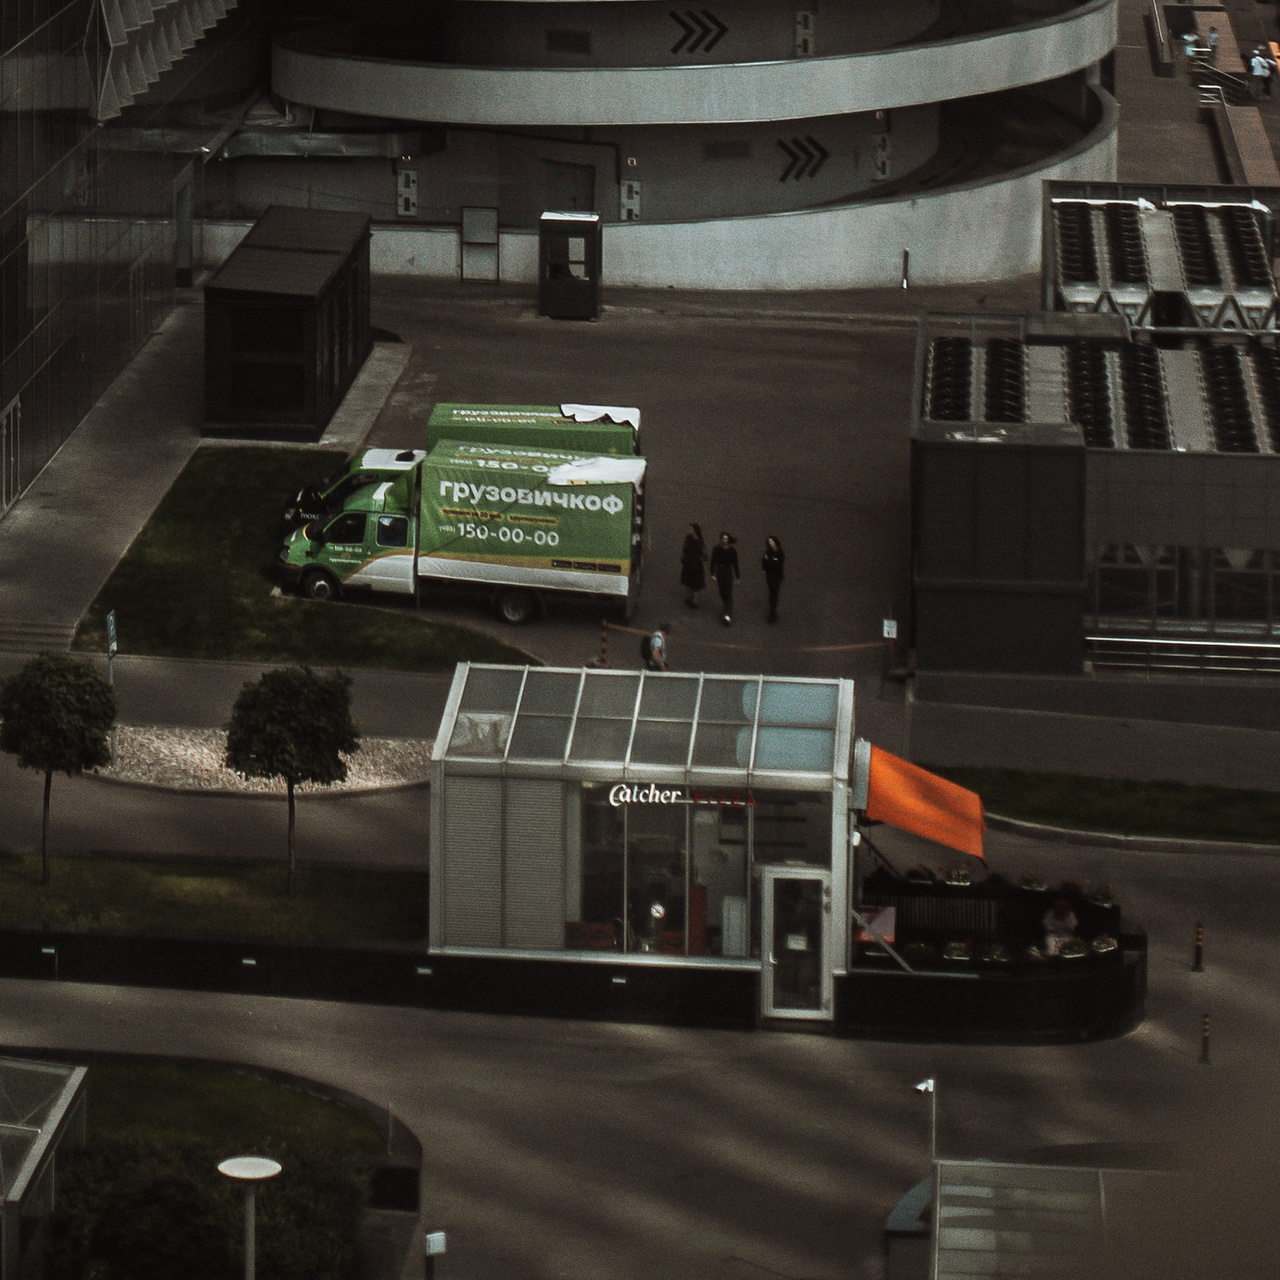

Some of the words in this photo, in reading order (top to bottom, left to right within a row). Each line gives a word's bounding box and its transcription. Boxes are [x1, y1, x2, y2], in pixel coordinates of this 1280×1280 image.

[439, 480, 624, 515] грузовичкоф
[458, 523, 560, 546] 150-00-00
[609, 783, 681, 807] Catcher
